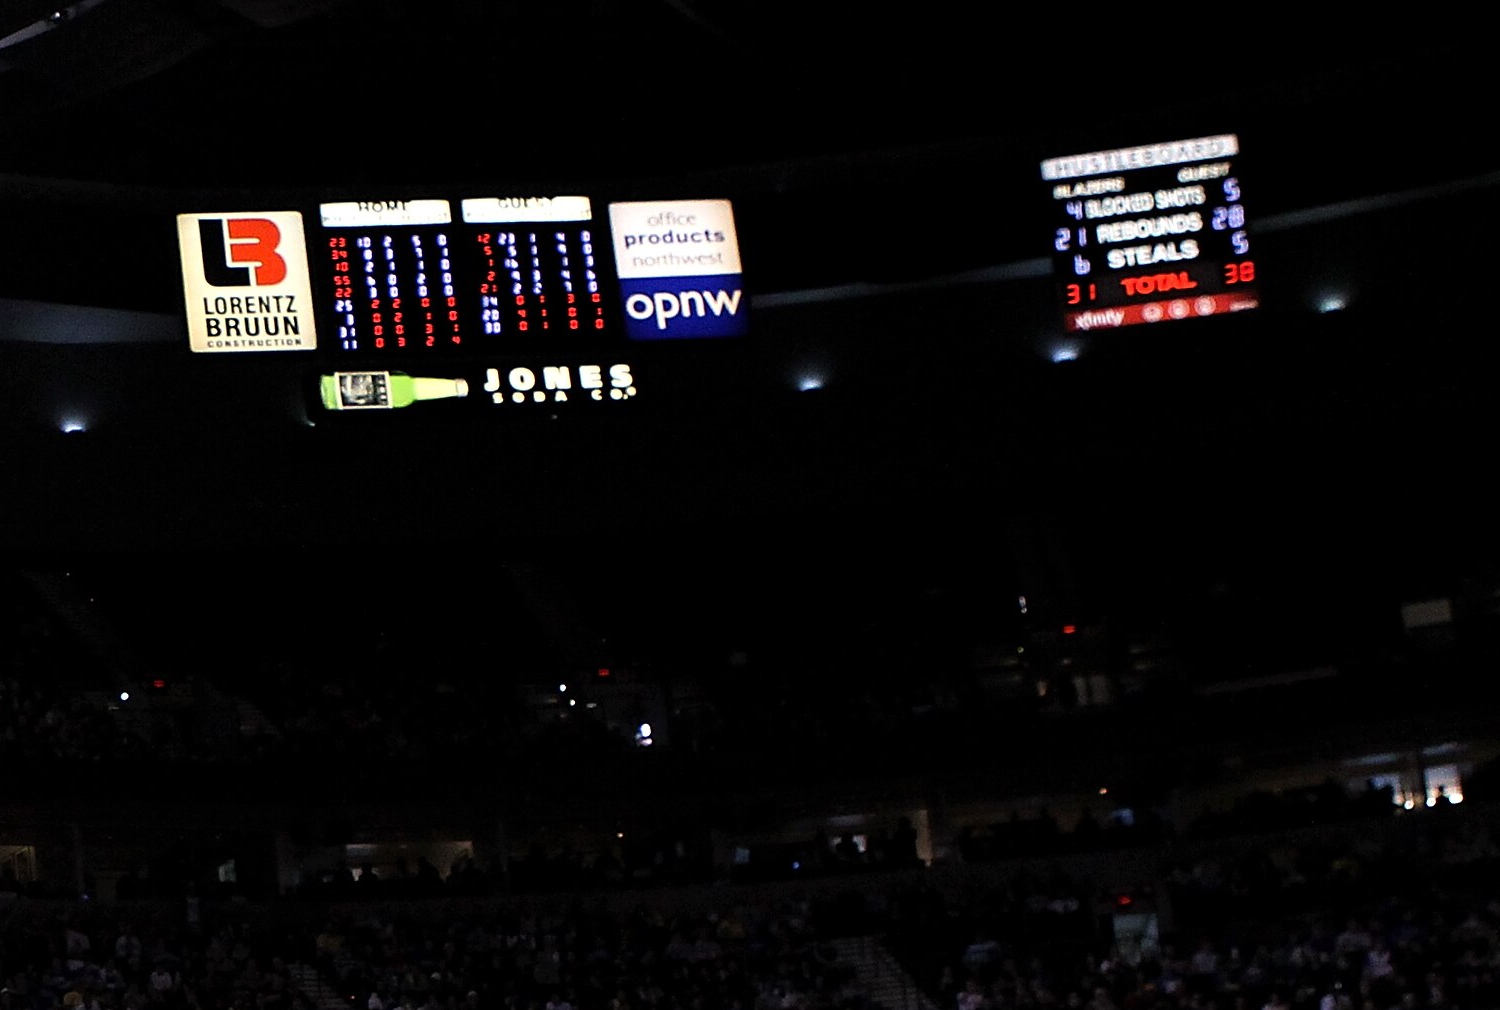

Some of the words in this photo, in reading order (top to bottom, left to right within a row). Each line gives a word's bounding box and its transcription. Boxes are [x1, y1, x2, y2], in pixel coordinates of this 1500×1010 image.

[1085, 192, 1154, 219] BLOCKED
[1154, 184, 1206, 209] SHOTS
[1223, 177, 1241, 202] 5
[647, 211, 696, 227] office
[1096, 211, 1203, 244] REBOUNDS
[624, 230, 725, 249] products
[1107, 239, 1200, 269] STEALS
[1232, 230, 1249, 254] 5
[632, 252, 723, 267] northwest
[336, 287, 352, 298] 22
[1066, 284, 1097, 305] 31
[1120, 271, 1198, 296] TOTAL
[1224, 261, 1255, 284] 38
[203, 295, 297, 315] LORENTZ
[626, 290, 741, 330] opnw
[205, 316, 300, 337] BRUUN
[207, 338, 302, 348] CONSTRUCTION
[484, 364, 633, 392] JONES
[492, 390, 567, 404] SODA
